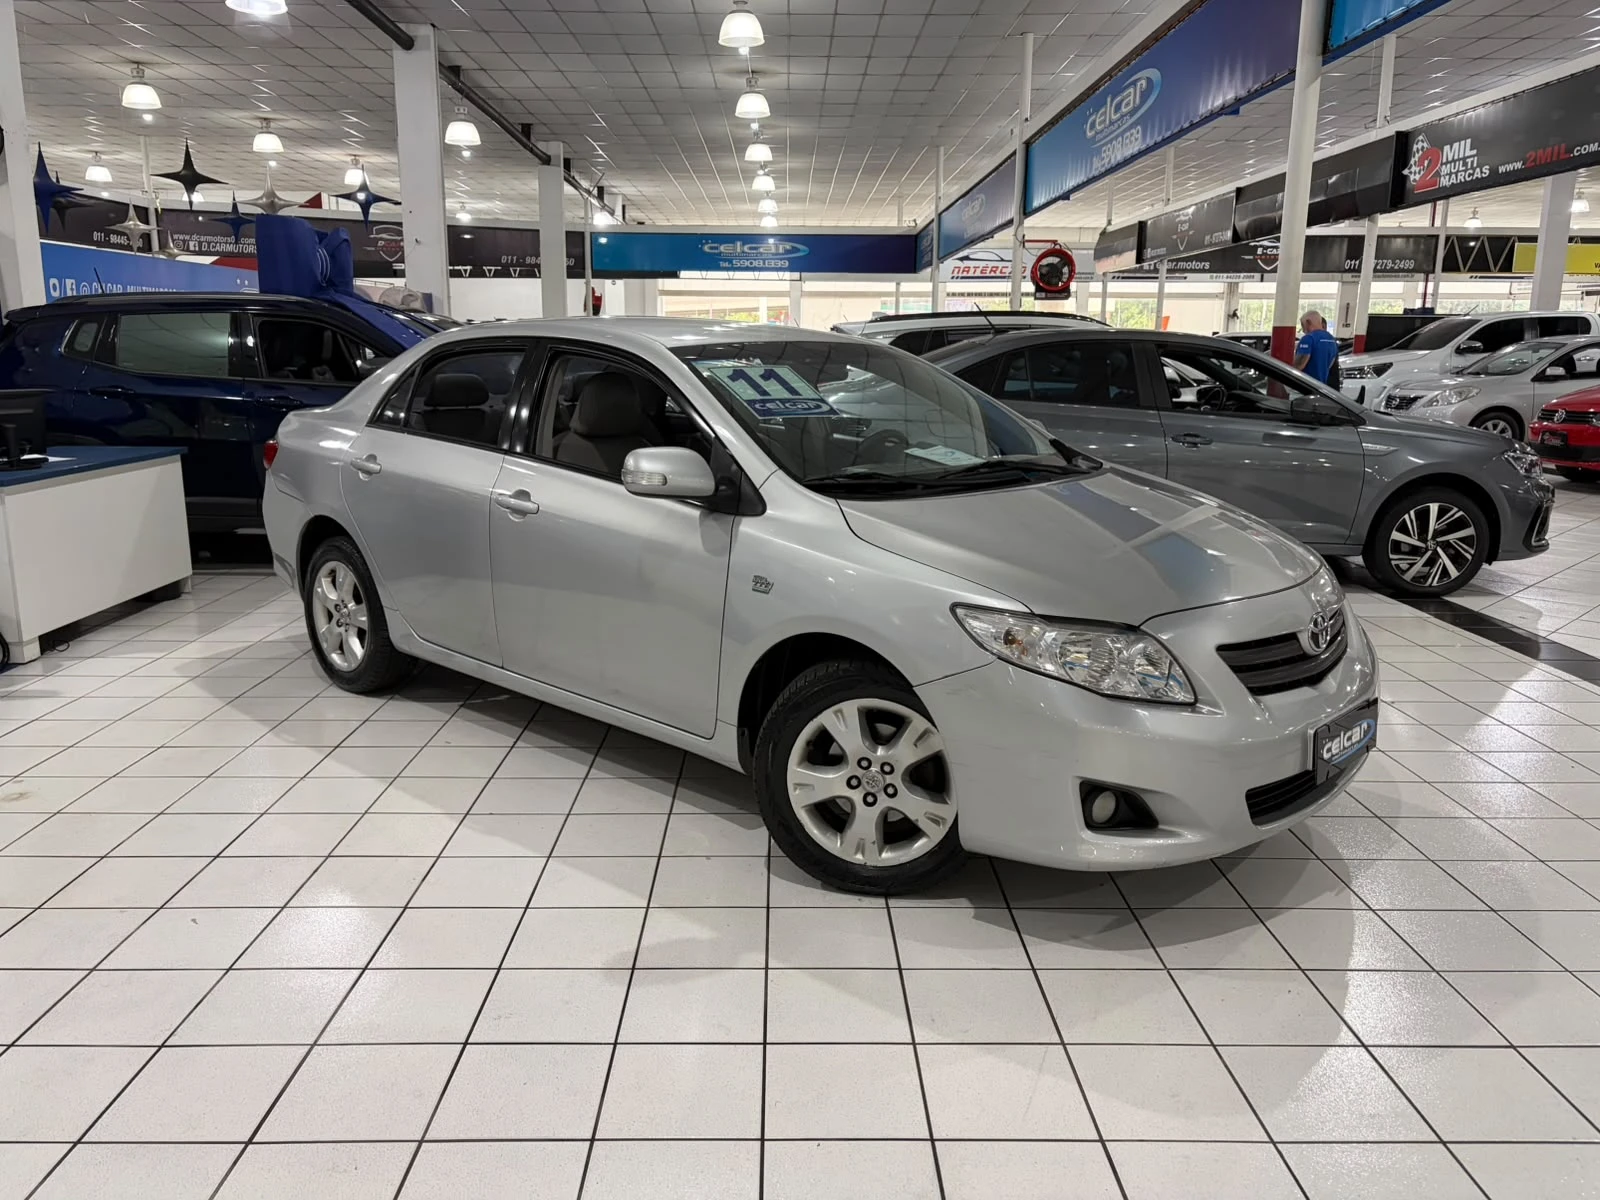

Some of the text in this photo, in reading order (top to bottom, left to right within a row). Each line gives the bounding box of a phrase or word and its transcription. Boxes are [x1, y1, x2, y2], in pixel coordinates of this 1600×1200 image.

[1086, 77, 1147, 138] celcar
[1442, 138, 1477, 161] MIL
[1441, 156, 1478, 176] MULTI
[1439, 165, 1490, 188] MARCAS
[93, 231, 104, 241] 011
[703, 241, 792, 253] celcar
[501, 255, 517, 264] 011
[1344, 260, 1359, 269] 011
[727, 369, 803, 396] 11
[754, 401, 819, 410] celcar
[1323, 721, 1368, 760] celcar
